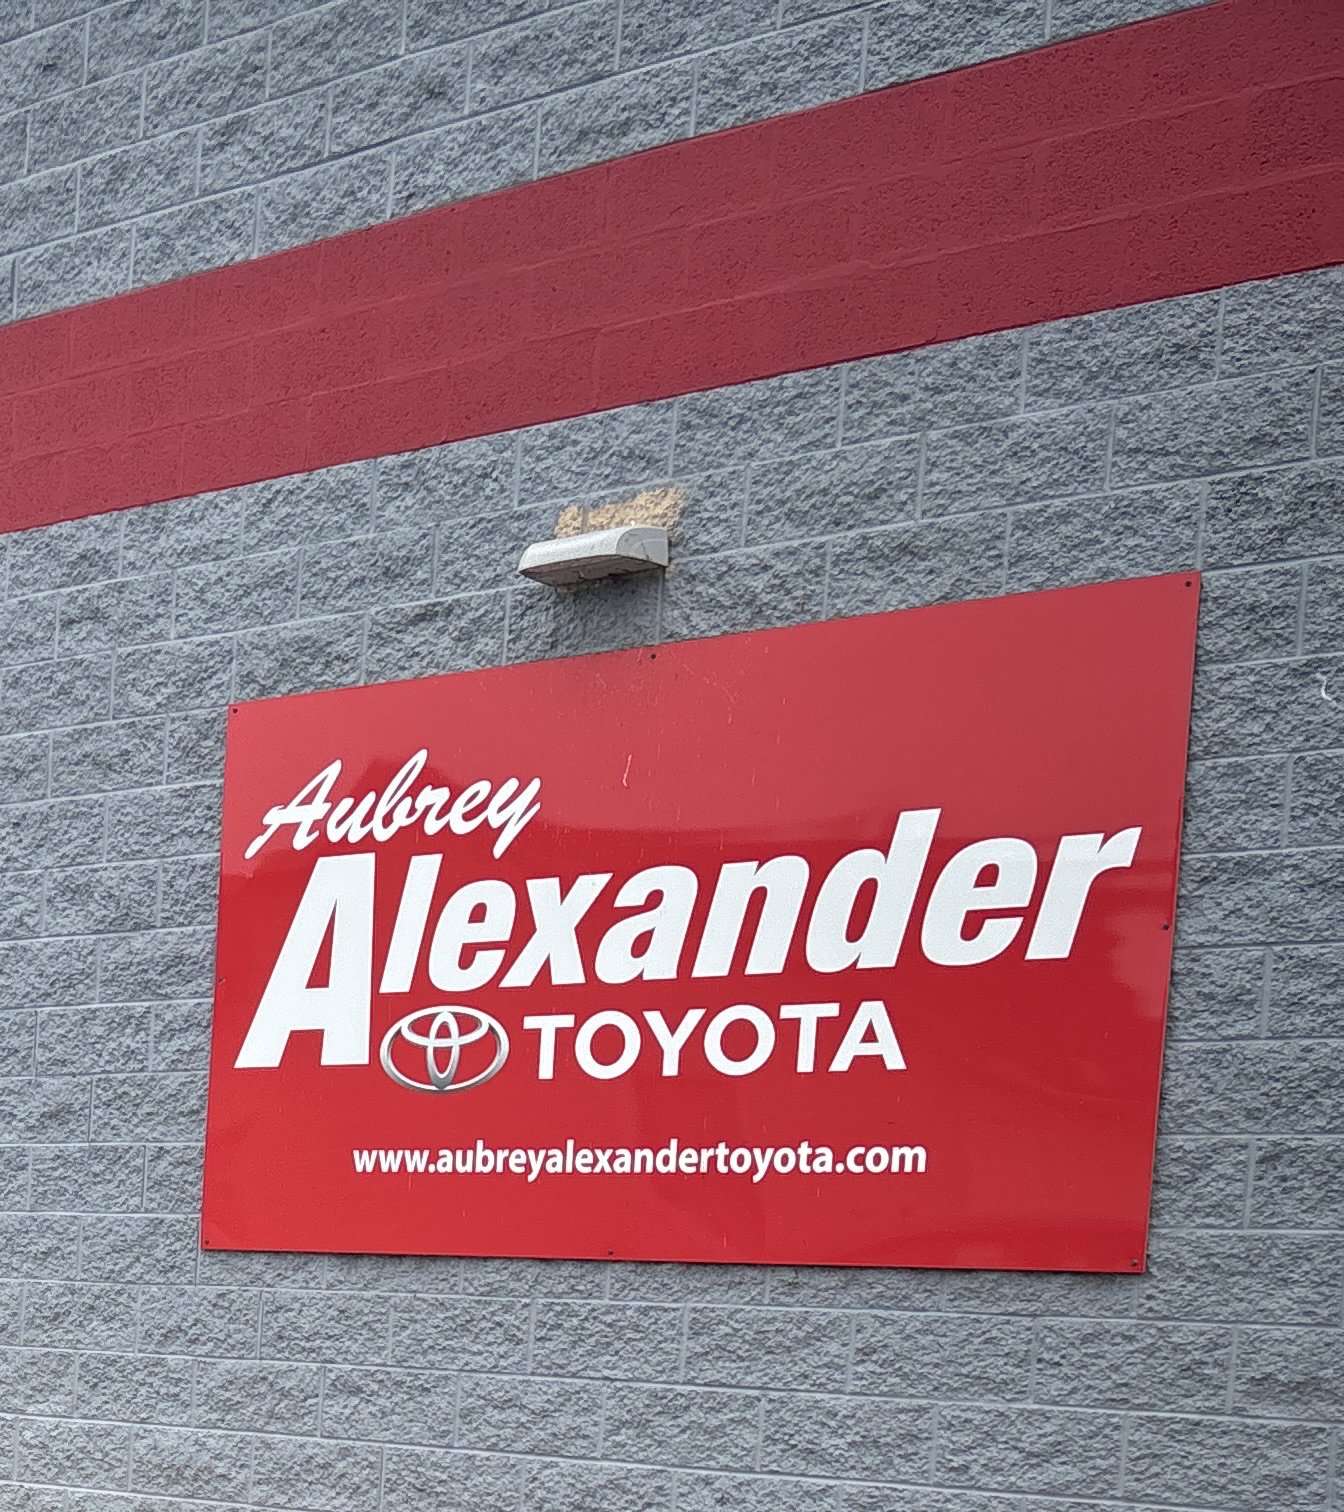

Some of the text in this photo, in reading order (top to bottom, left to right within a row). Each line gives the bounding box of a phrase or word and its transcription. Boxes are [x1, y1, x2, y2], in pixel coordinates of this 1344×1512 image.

[244, 748, 541, 861] Aubrey
[233, 807, 1143, 1069] Alexander
[523, 1000, 907, 1080] TOYOTA
[352, 1138, 927, 1184] www.aubreyalexandertoyota.com
